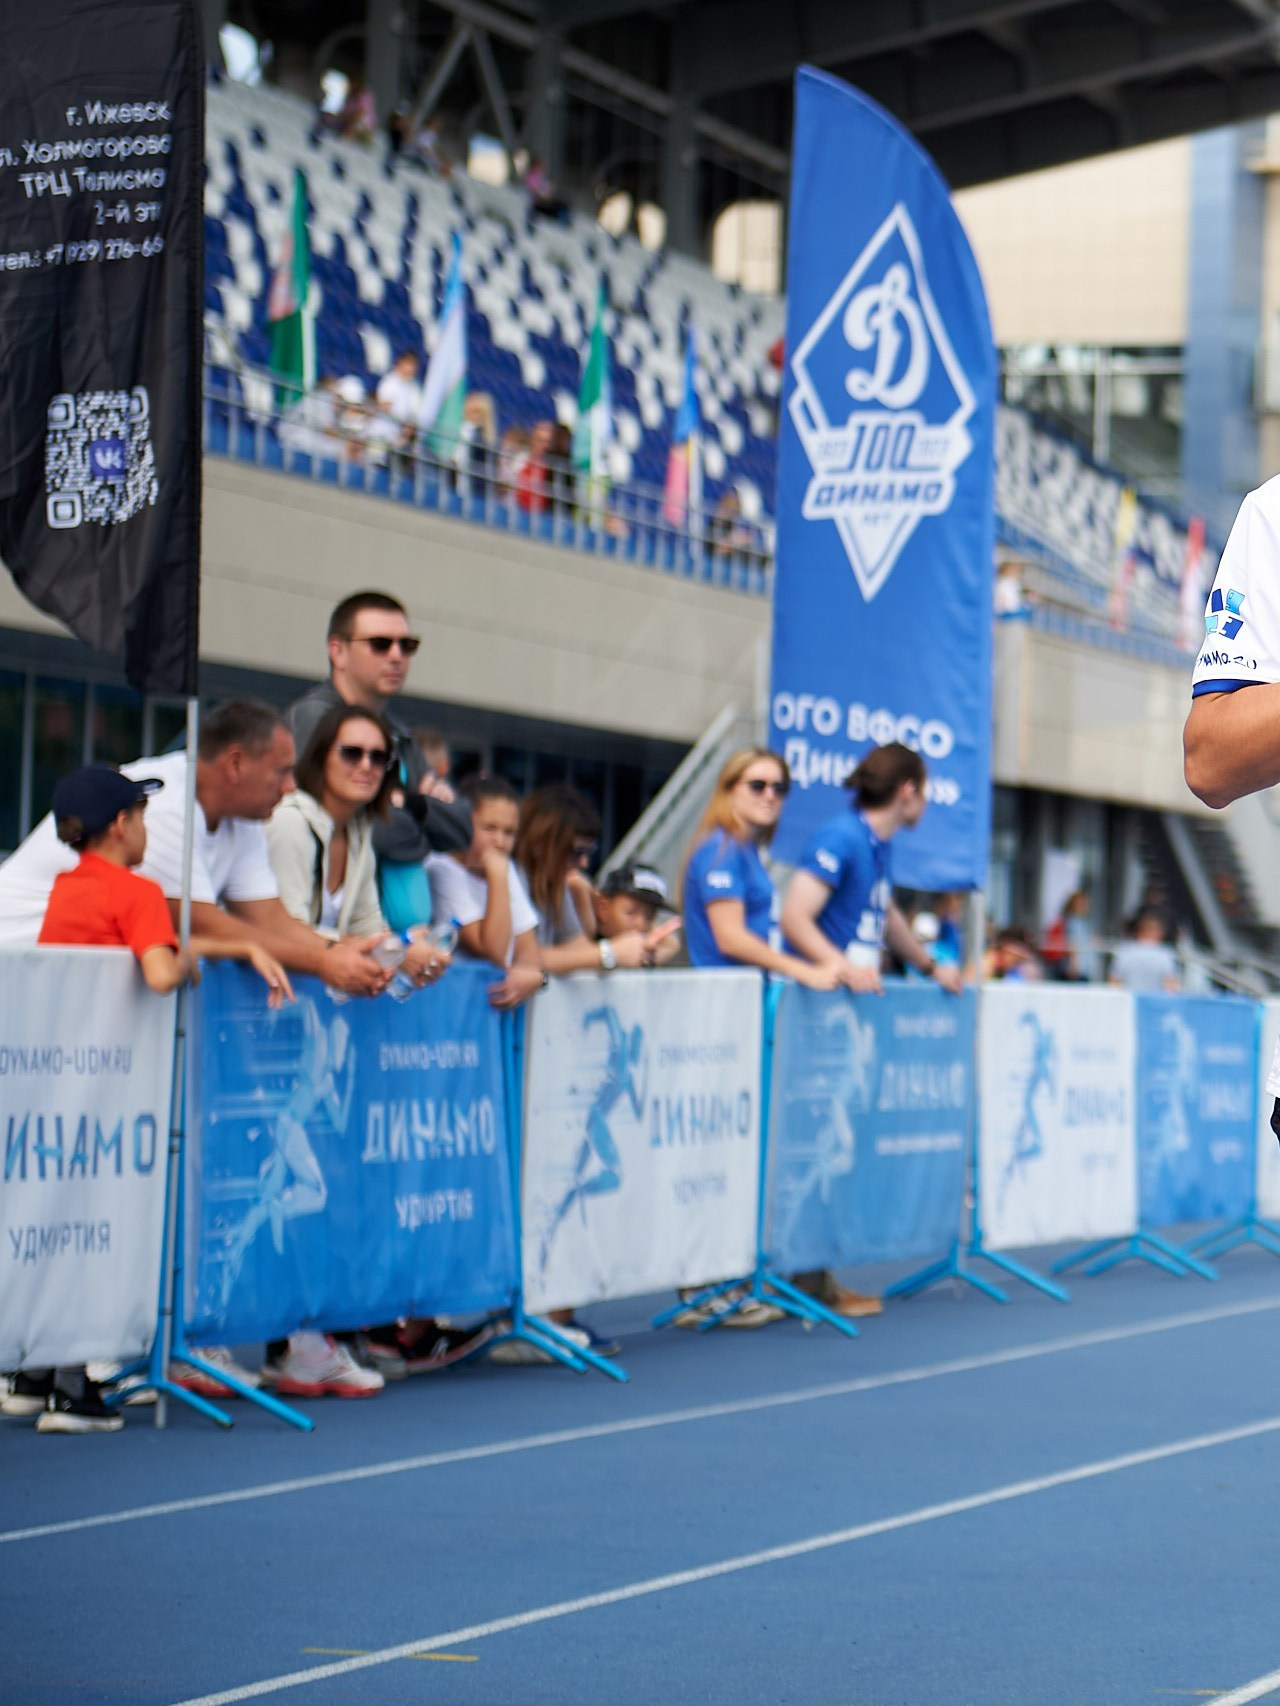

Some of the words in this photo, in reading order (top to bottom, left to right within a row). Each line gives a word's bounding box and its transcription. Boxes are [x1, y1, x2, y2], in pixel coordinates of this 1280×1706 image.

[66, 106, 83, 126] г.
[85, 101, 173, 125] Ижевск
[18, 172, 72, 198] ТРЦ
[814, 482, 943, 507] ДИНАМО
[773, 692, 842, 736] ОГО
[847, 702, 954, 759] ВФСО
[361, 1096, 495, 1164] ДИНАМО
[9, 1220, 111, 1265] УДМУРТИЯ
